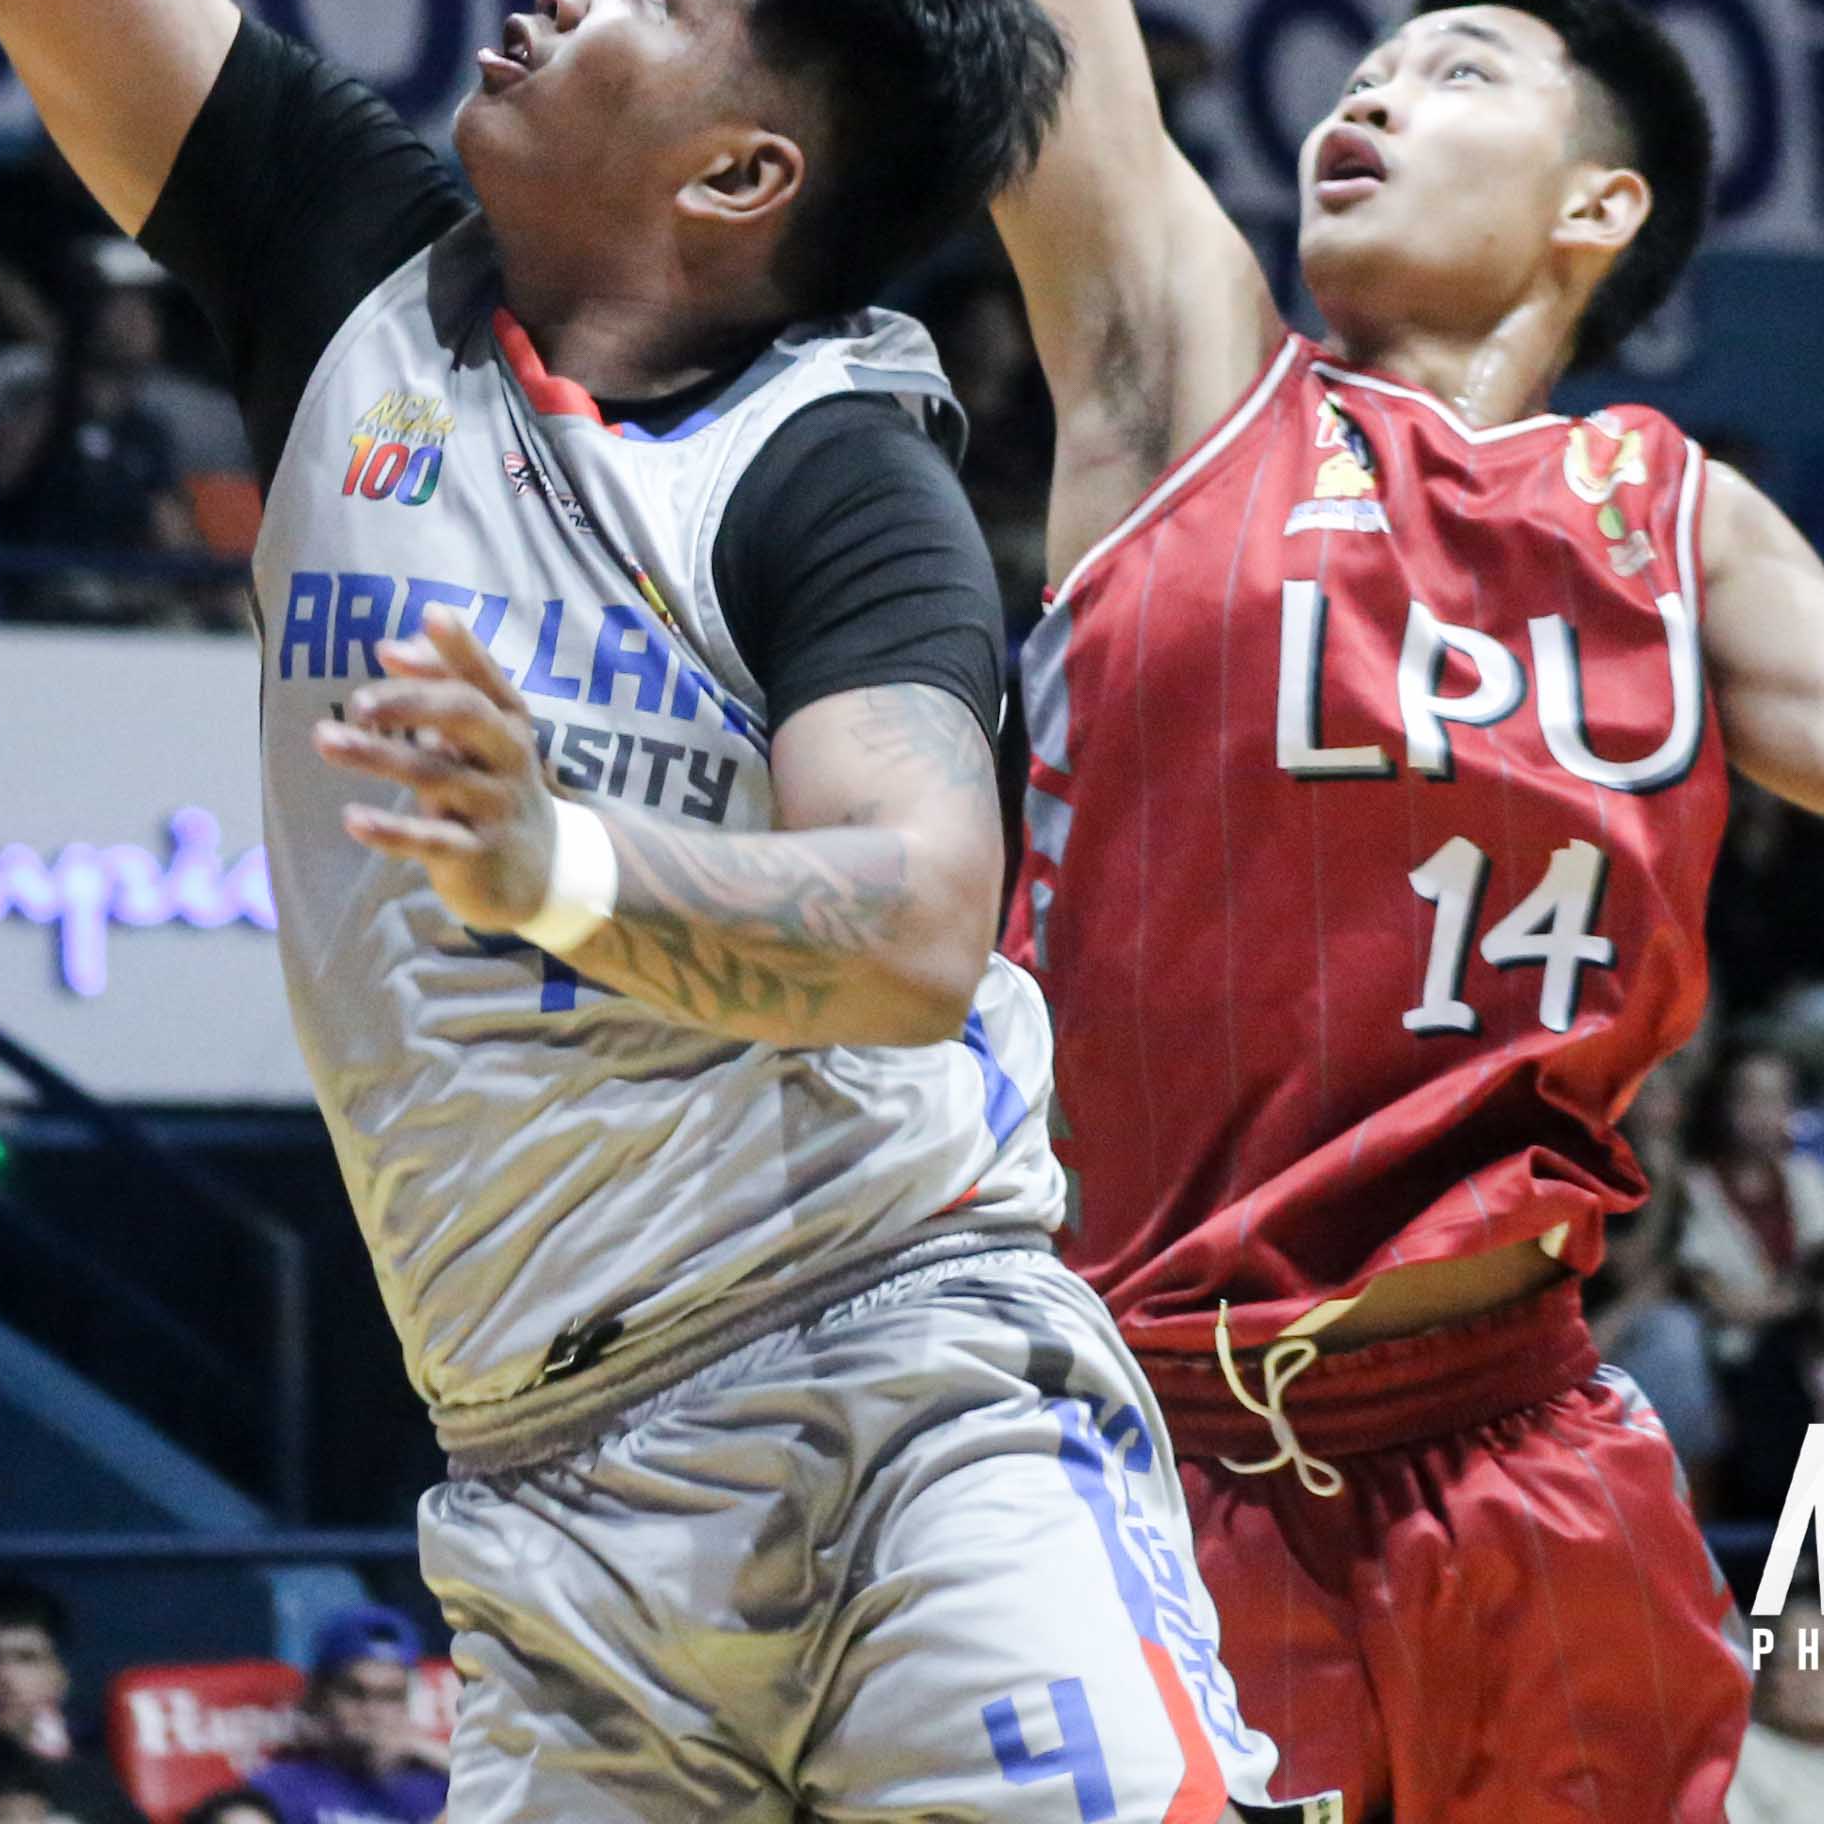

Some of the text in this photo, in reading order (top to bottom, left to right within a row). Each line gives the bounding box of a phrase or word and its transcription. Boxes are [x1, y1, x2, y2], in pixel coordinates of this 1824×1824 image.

[341, 433, 443, 507] 100
[1276, 579, 1705, 794] LPU
[1402, 834, 1617, 1037] 14
[980, 1676, 1118, 1823] 4
